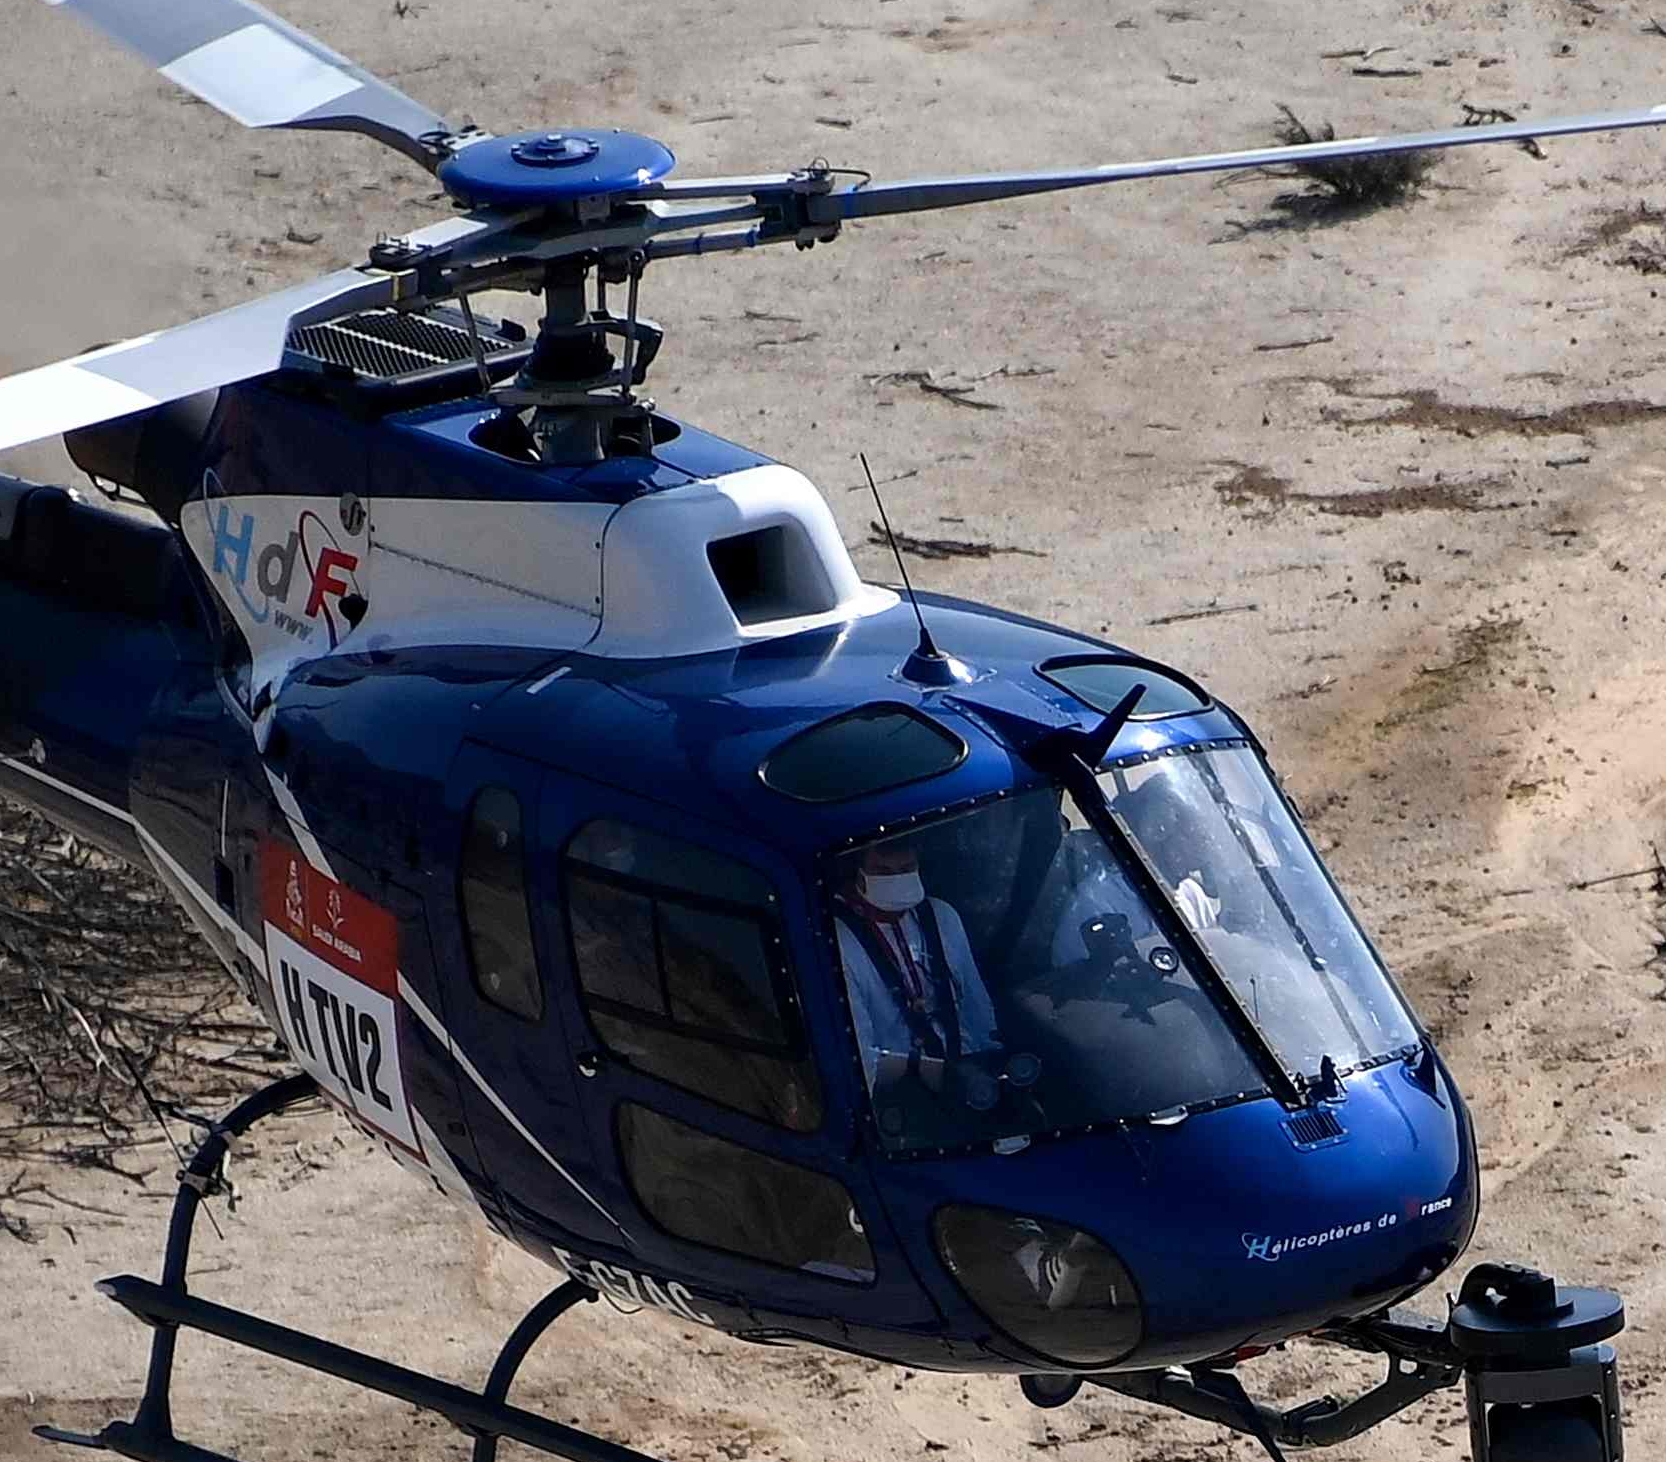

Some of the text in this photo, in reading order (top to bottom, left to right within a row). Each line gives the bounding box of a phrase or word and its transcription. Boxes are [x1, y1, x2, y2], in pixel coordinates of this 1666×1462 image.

[213, 505, 358, 618] HdF
[1244, 1220, 1372, 1261] Hélicoptères
[1377, 1212, 1398, 1229] de
